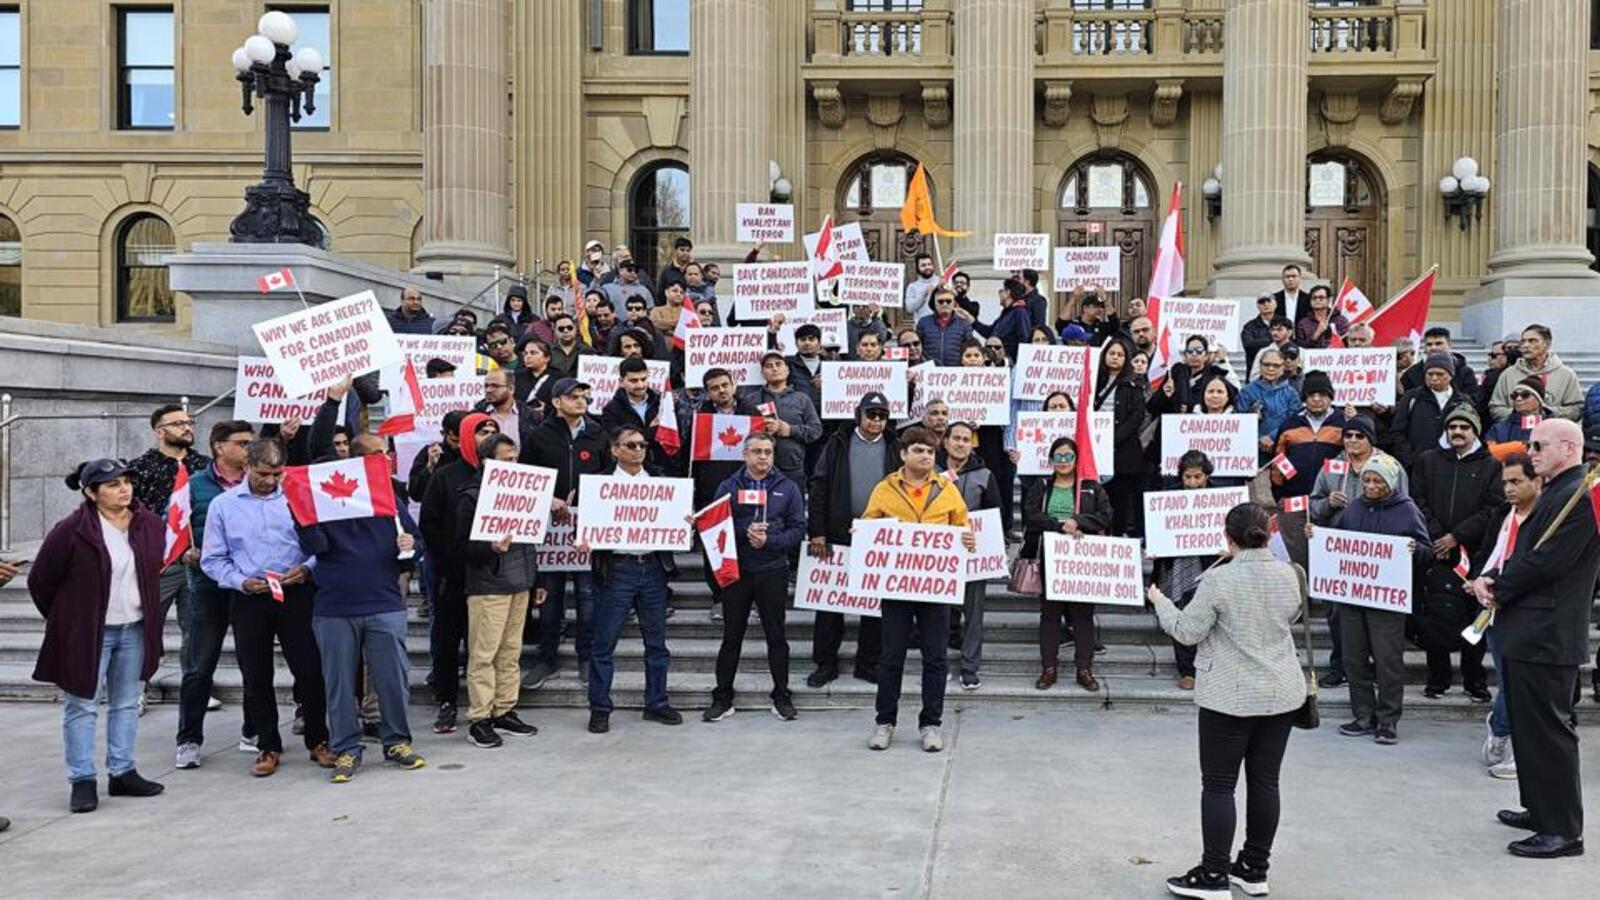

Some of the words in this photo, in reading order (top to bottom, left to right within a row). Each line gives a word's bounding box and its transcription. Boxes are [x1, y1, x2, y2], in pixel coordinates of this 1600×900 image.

[750, 229, 784, 240] TERROR
[997, 236, 1044, 247] PROTECT
[1005, 247, 1037, 257] HINDU
[1064, 251, 1109, 262] CANADIAN
[998, 257, 1044, 268] TEMPLES
[1074, 264, 1101, 275] HINDU
[736, 267, 759, 281] SAVE
[760, 265, 808, 280] CANADIANS
[845, 265, 857, 275] NO
[858, 265, 882, 277] ROOM
[883, 266, 899, 277] FOR
[736, 283, 760, 296] FROM
[844, 277, 889, 291] TERRORISM
[891, 280, 899, 290] IN
[1056, 277, 1080, 288] LIVES
[1081, 277, 1118, 288] MATTER
[841, 290, 882, 302] CANADIAN
[883, 291, 900, 303] SOIL
[750, 298, 798, 312] TERRORISM
[1162, 301, 1194, 315] STAND
[1196, 302, 1237, 316] AGAINST
[260, 325, 288, 344] WHY
[289, 318, 309, 336] WE
[311, 311, 333, 329] ARE
[334, 298, 374, 321] HERE??
[1172, 317, 1227, 332] KHALISTANI
[280, 341, 307, 360] FOR
[309, 319, 374, 347] CANADIAN
[406, 340, 420, 350] WE
[422, 340, 438, 351] ARE
[689, 333, 719, 349] STOP
[720, 333, 765, 349] ATTACK
[299, 347, 341, 372] PEACE
[343, 338, 369, 357] AND
[690, 352, 707, 366] ON
[708, 350, 763, 367] CANADIAN
[1032, 349, 1053, 362] ALL
[1309, 355, 1335, 367] WHO
[1336, 354, 1359, 367] ARE
[1361, 353, 1393, 367] WE??
[244, 363, 275, 378] WHO
[310, 354, 373, 386] HARMONY
[582, 361, 609, 375] WHO
[837, 366, 892, 381] CANADIAN
[1025, 366, 1044, 379] ON
[927, 372, 958, 388] STOP
[960, 372, 1007, 389] ATTACK
[1022, 382, 1036, 395] IN
[459, 381, 483, 397] FOR
[927, 390, 945, 404] ON
[947, 390, 1006, 406] CANADIAN
[1058, 418, 1076, 428] ARE
[1179, 419, 1240, 434] CANADIAN
[1188, 438, 1231, 452] HINDUS
[487, 468, 551, 492] PROTECT
[599, 482, 675, 502] CANADIAN
[493, 492, 537, 514] HINDU
[1149, 495, 1188, 512] STAND
[1192, 491, 1244, 509] AGAINST
[613, 504, 660, 523] HINDU
[480, 514, 542, 537] TEMPLES
[581, 526, 623, 545] LIVES
[626, 527, 688, 545] MATTER
[873, 527, 904, 547] ALL
[911, 530, 954, 550] EYES
[1174, 532, 1223, 550] TERROR
[1054, 539, 1073, 556] NO
[1074, 541, 1108, 558] ROOM
[1110, 543, 1134, 561] FOR
[1325, 536, 1393, 560] CANADIAN
[864, 550, 889, 568] ON
[894, 552, 960, 574] HINDUS
[1054, 559, 1121, 579] TERRORISM
[1123, 564, 1136, 580] IN
[1339, 559, 1380, 581] HINDU
[810, 568, 832, 585] ON
[861, 573, 880, 591] IN
[885, 574, 958, 597] CANADA
[1052, 580, 1112, 598] CANADIAN
[1114, 582, 1139, 600] SOIL
[1313, 576, 1348, 598] LIVES
[1351, 582, 1408, 607] MATTER
[806, 588, 822, 603] IN
